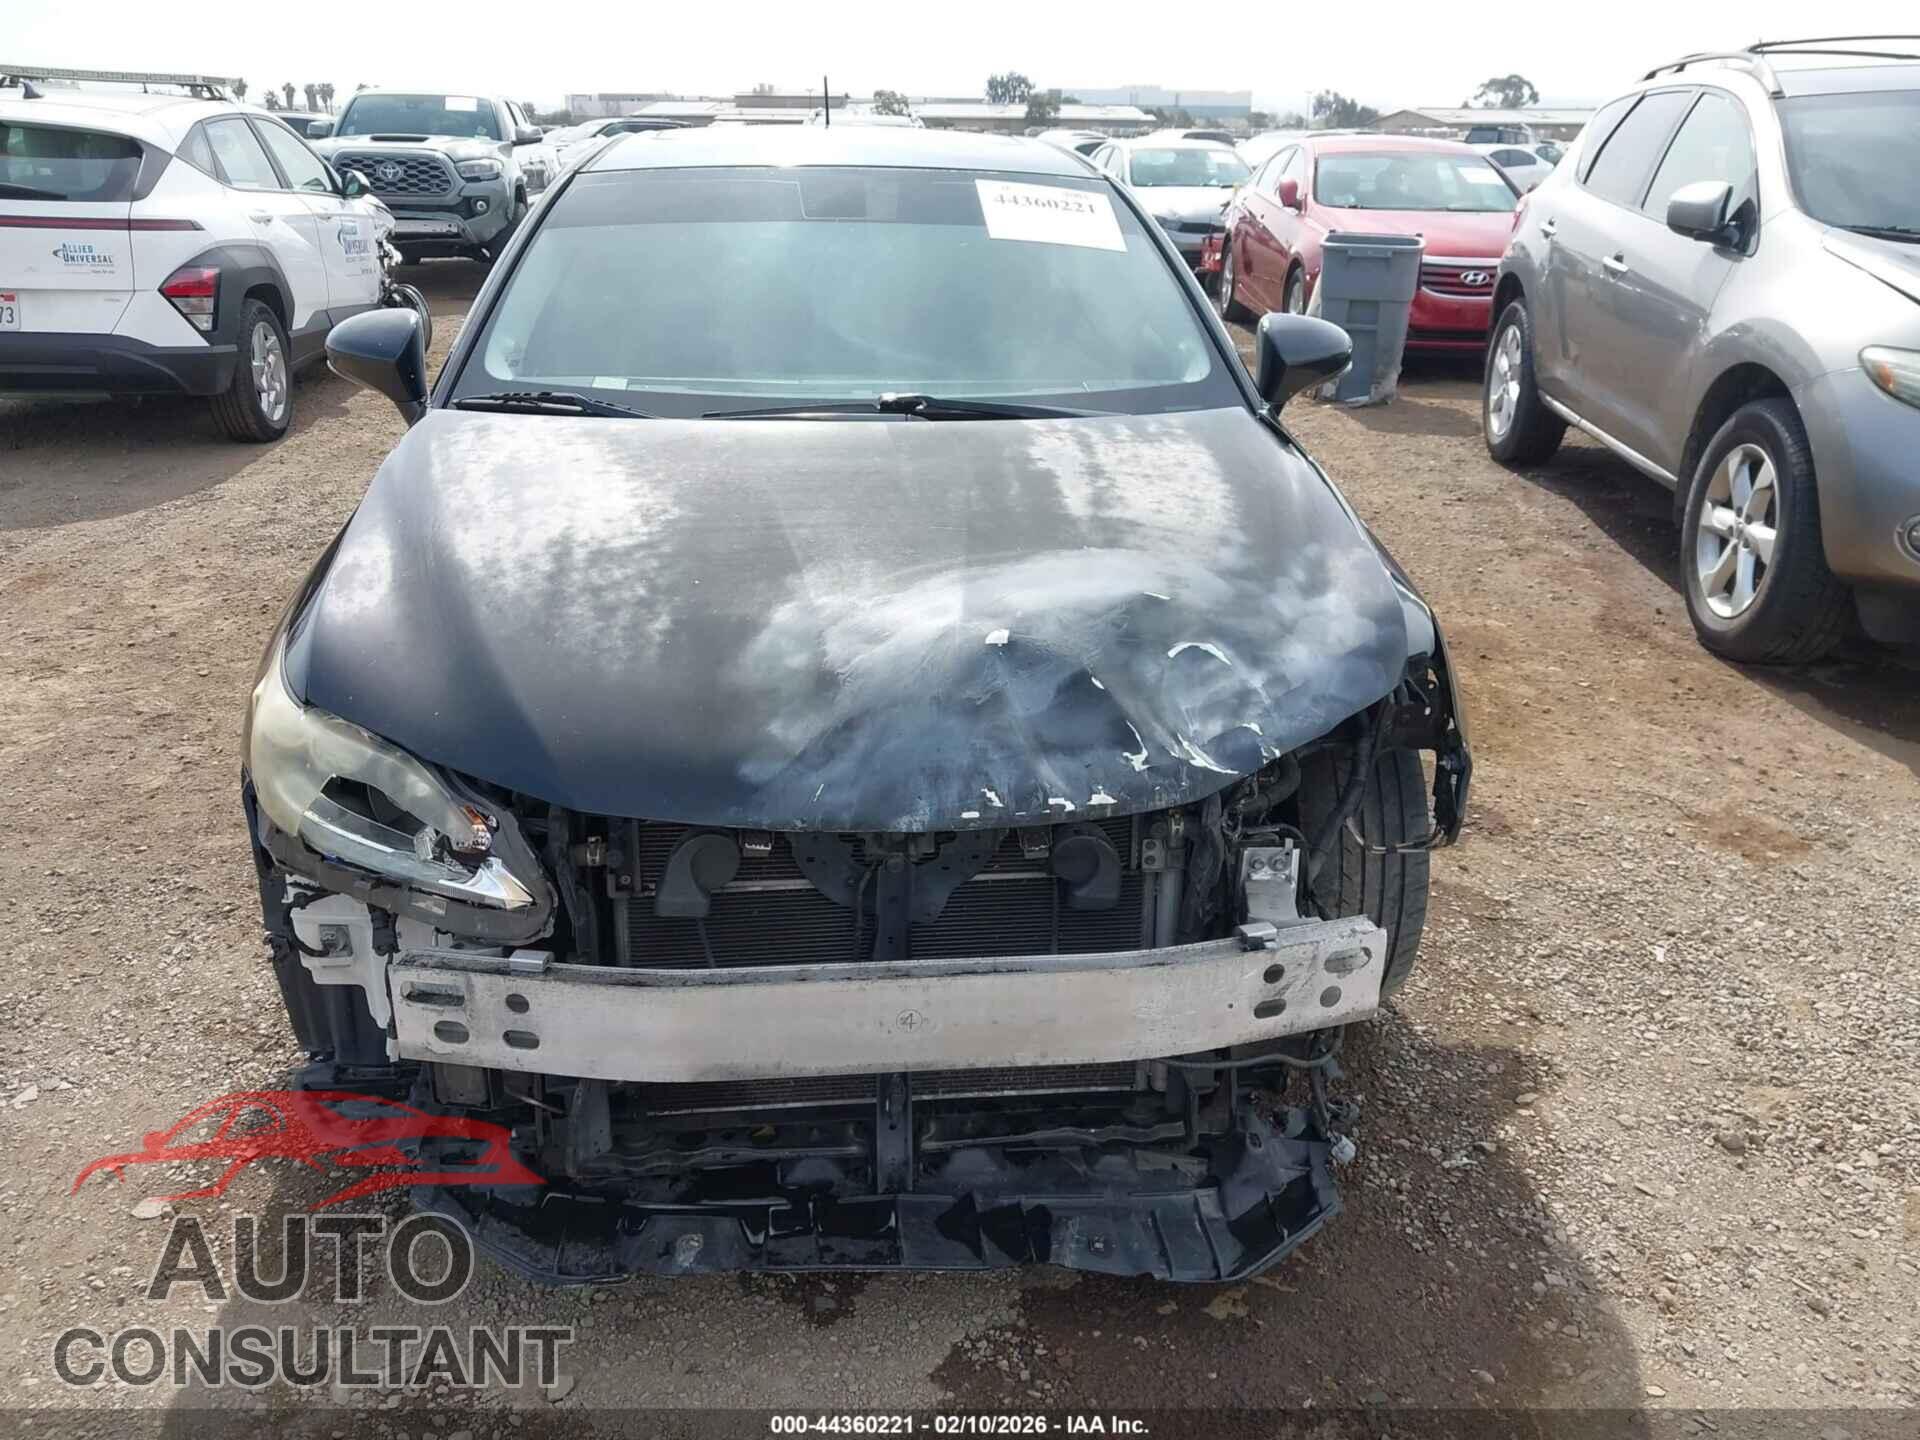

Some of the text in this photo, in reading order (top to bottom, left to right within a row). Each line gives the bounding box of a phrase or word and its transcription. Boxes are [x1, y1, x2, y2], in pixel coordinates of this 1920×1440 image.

[994, 193, 1096, 213] 44360221
[62, 243, 94, 253] ALLIED
[63, 253, 113, 263] UNIVERSAL
